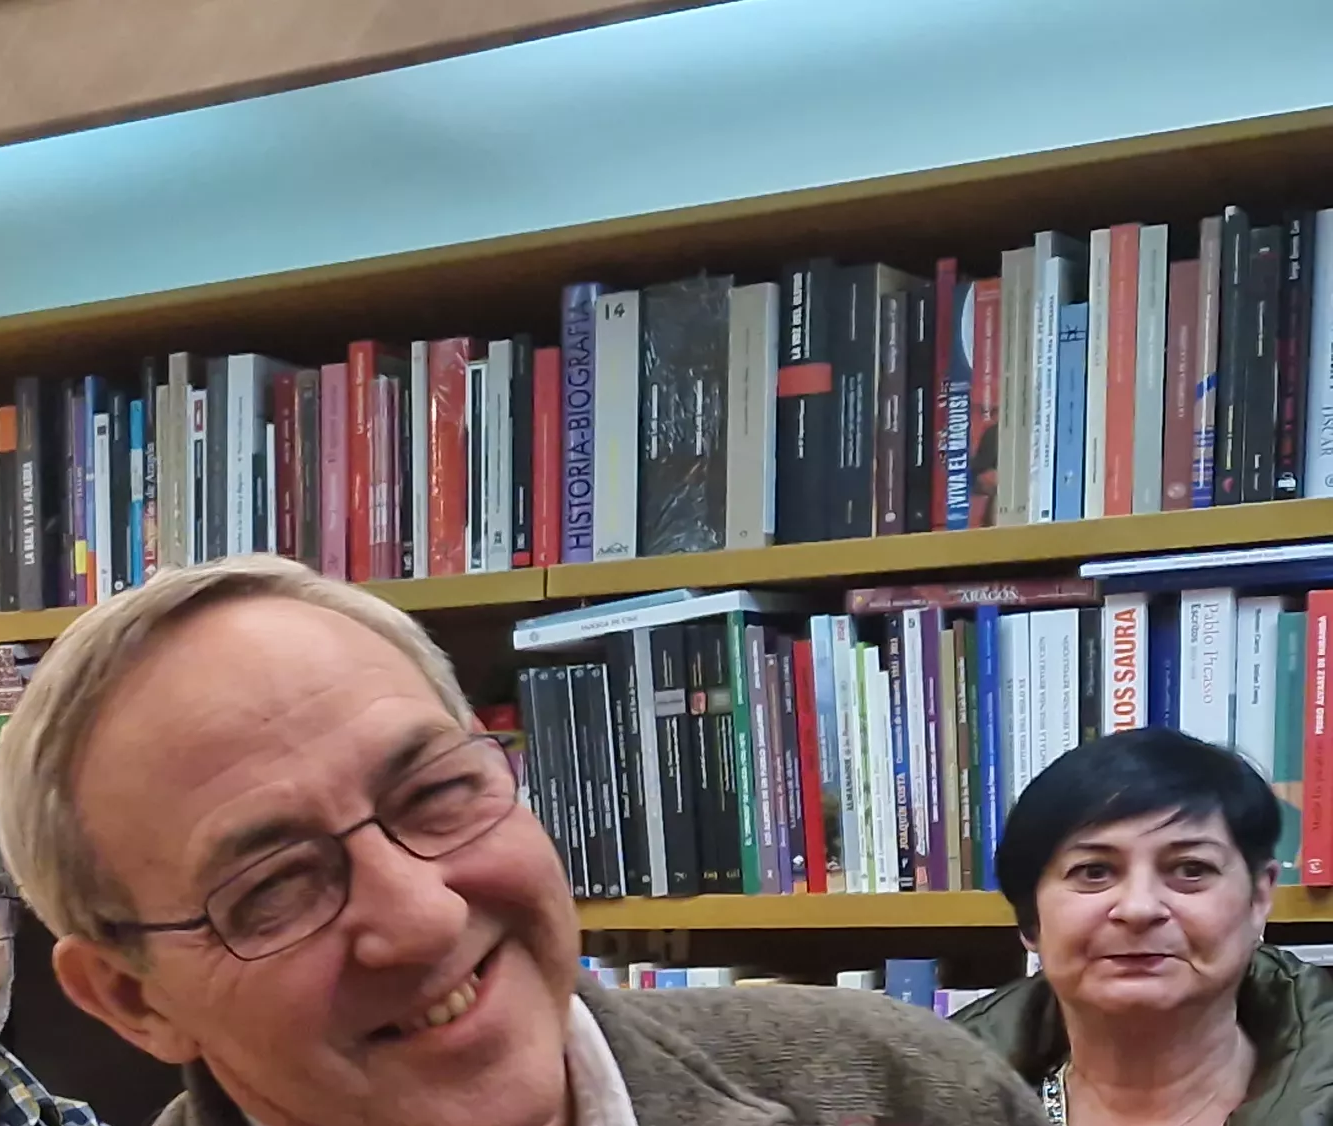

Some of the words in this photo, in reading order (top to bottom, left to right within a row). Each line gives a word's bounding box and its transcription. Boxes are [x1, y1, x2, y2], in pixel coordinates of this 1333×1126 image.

[947, 456, 969, 471] EL
[1113, 607, 1137, 682] SAURA
[1190, 603, 1202, 643] Escritos
[1203, 602, 1220, 646] Pablo
[1202, 649, 1219, 705] Picasso
[1113, 686, 1137, 736] LOS
[895, 772, 907, 804] COSTA
